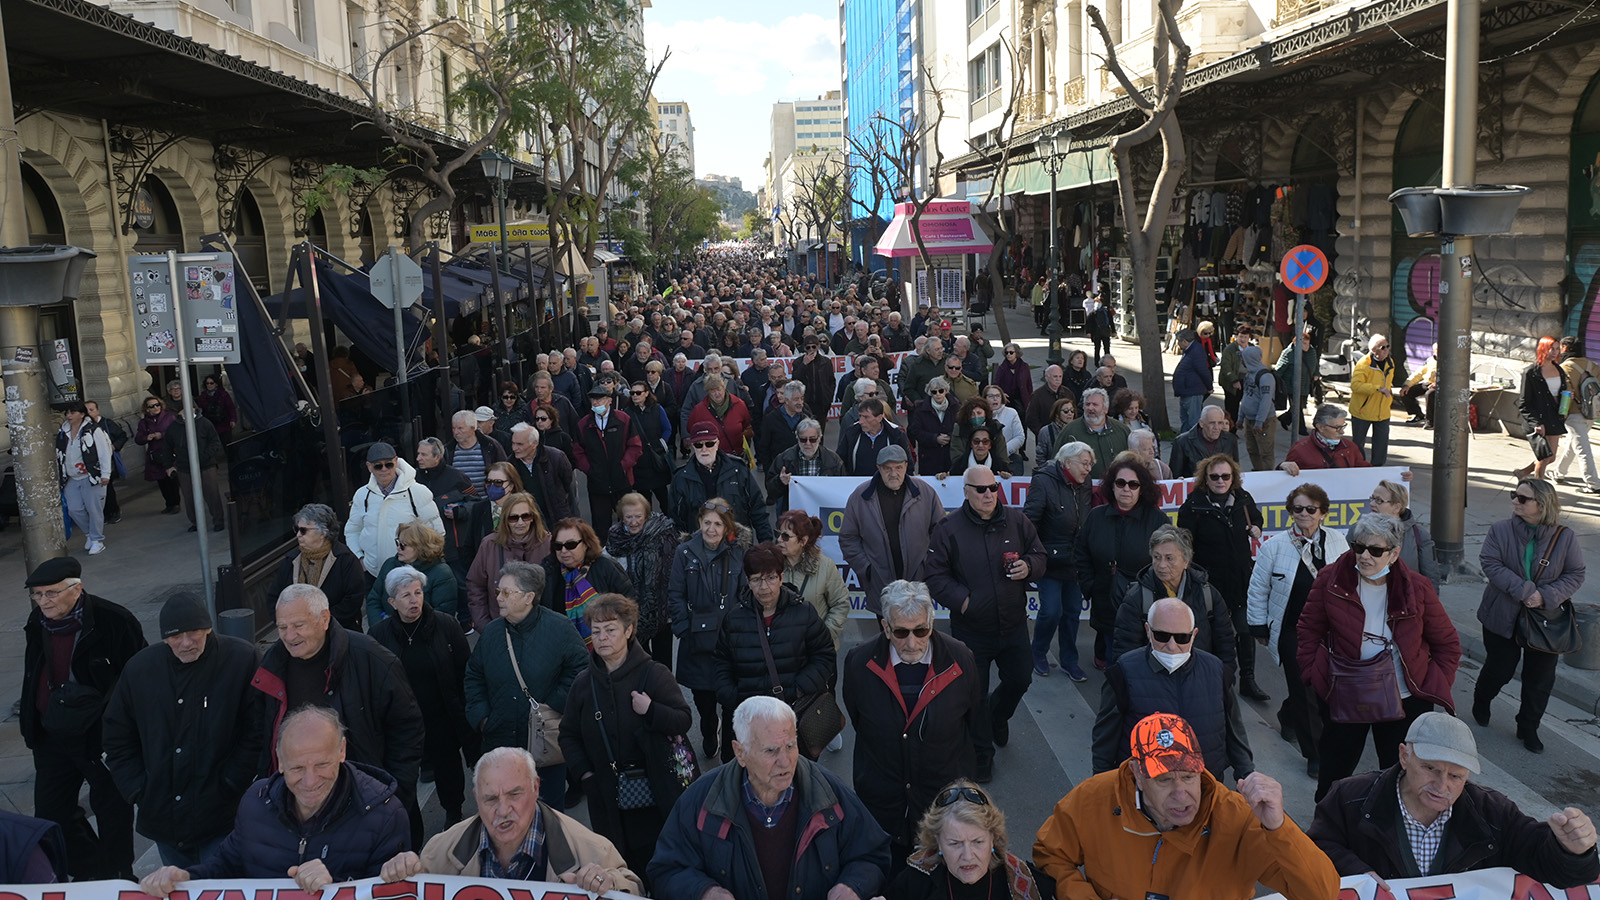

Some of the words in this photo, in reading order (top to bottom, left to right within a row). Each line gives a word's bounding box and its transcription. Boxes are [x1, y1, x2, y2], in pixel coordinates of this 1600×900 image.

[940, 203, 967, 213] Center
[475, 229, 498, 237] Μάθε
[512, 229, 528, 237] όλα
[75, 462, 87, 474] 3
